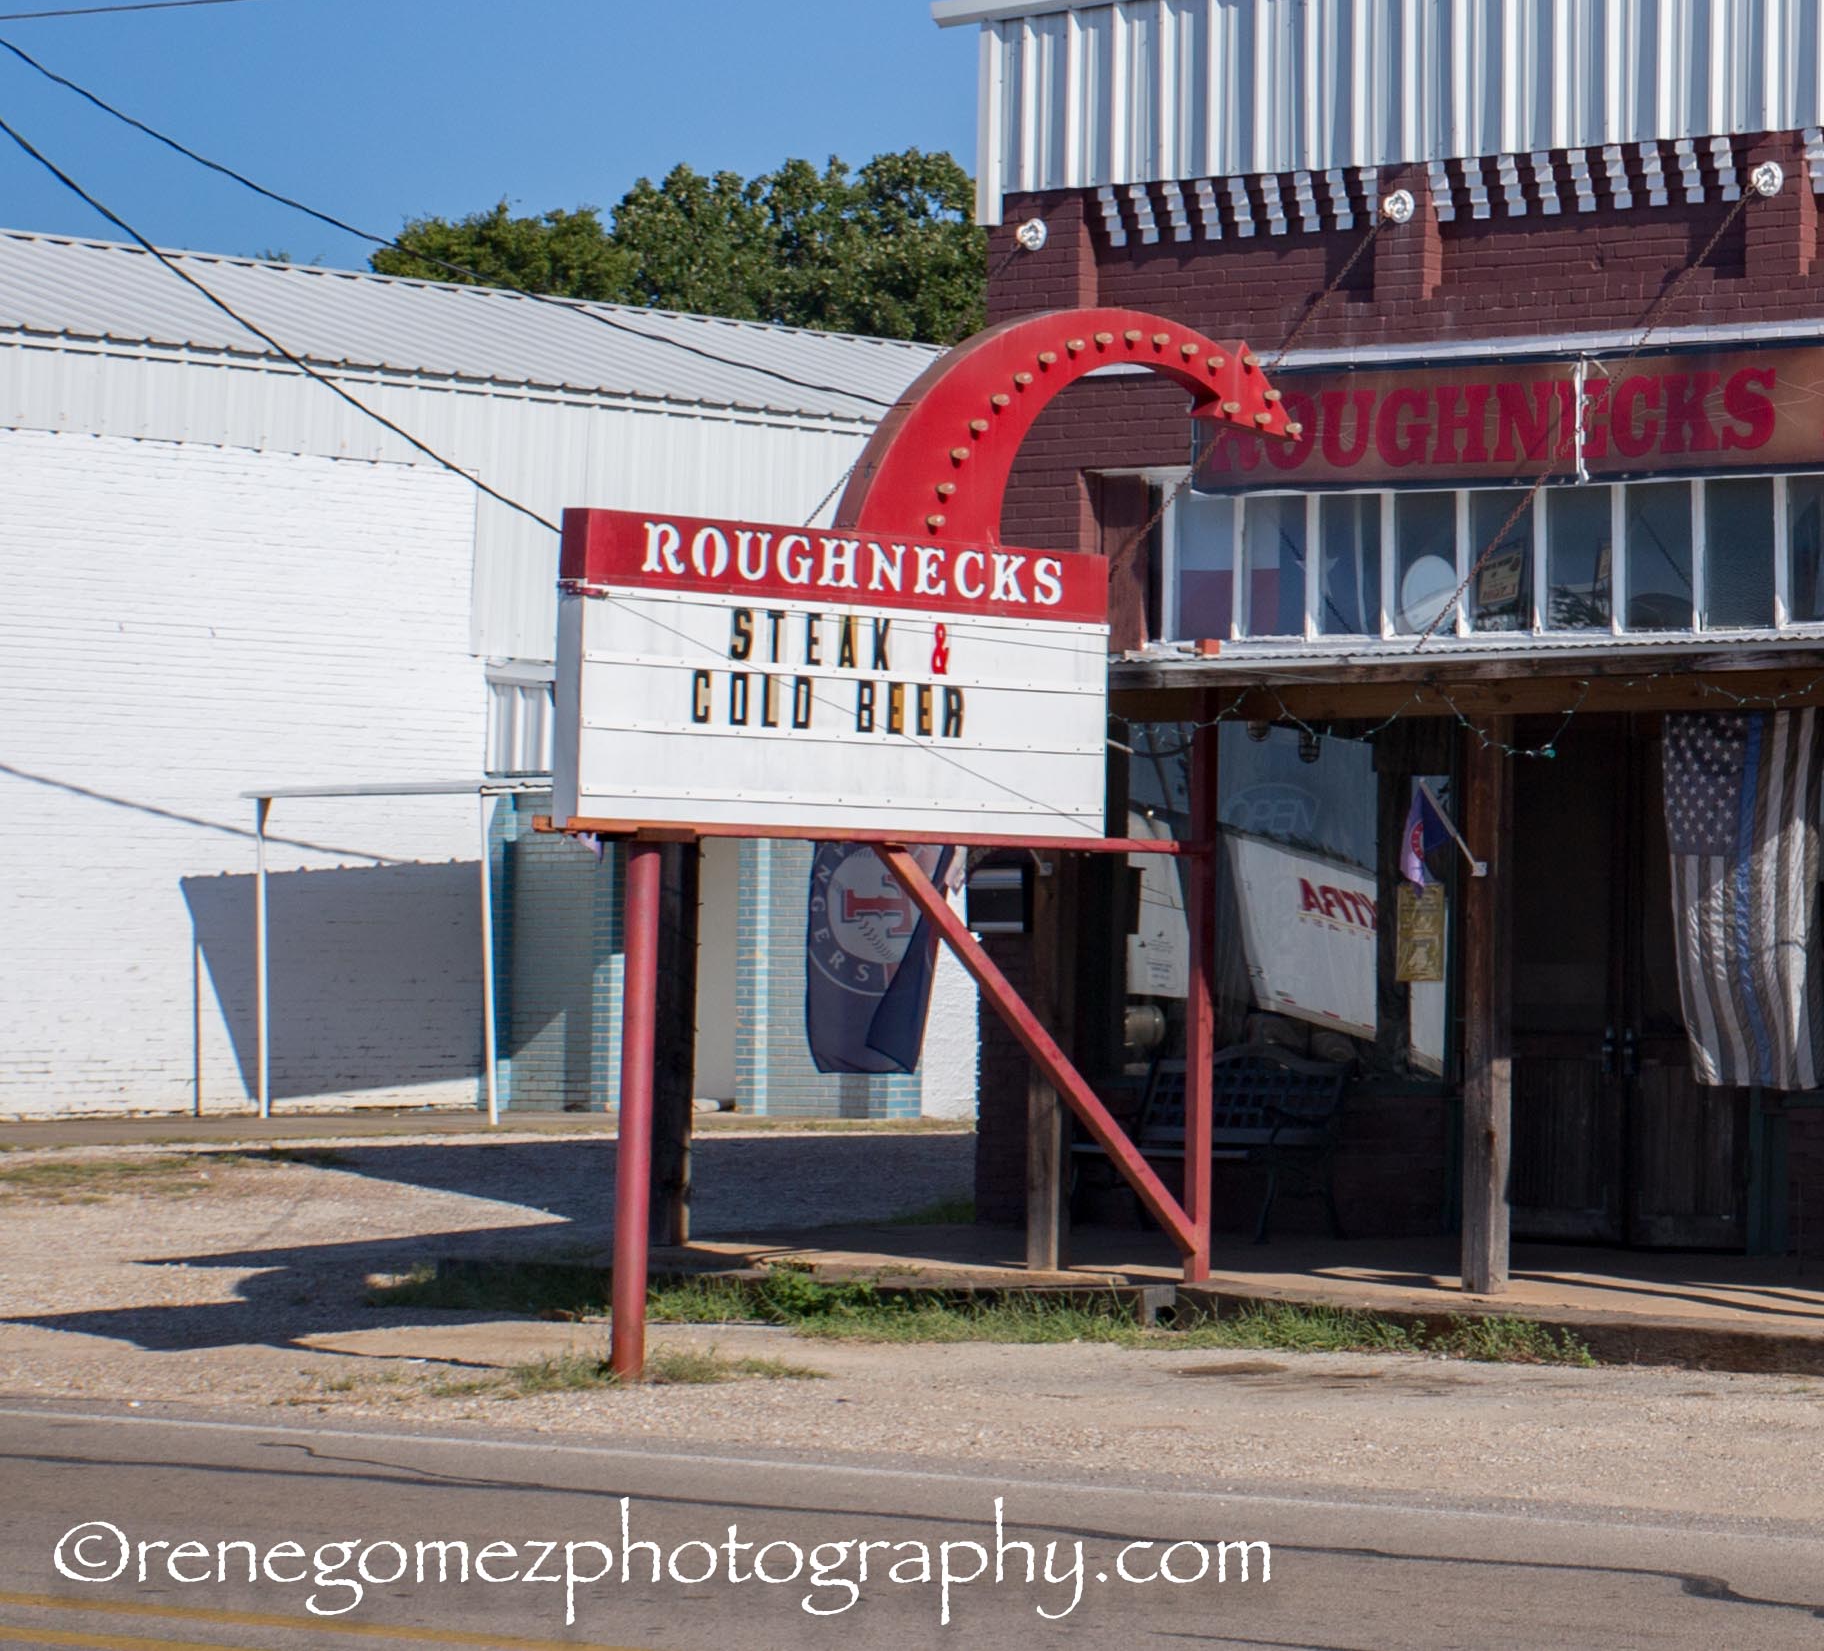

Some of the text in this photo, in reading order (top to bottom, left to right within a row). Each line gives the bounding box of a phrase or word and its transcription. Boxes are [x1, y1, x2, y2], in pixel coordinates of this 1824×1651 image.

[641, 520, 1064, 607] ROUGHNECKS
[729, 606, 950, 675] STEAK &
[692, 669, 965, 738] COLD BEER
[1222, 796, 1321, 834] OPEN
[810, 845, 871, 982] NGERS
